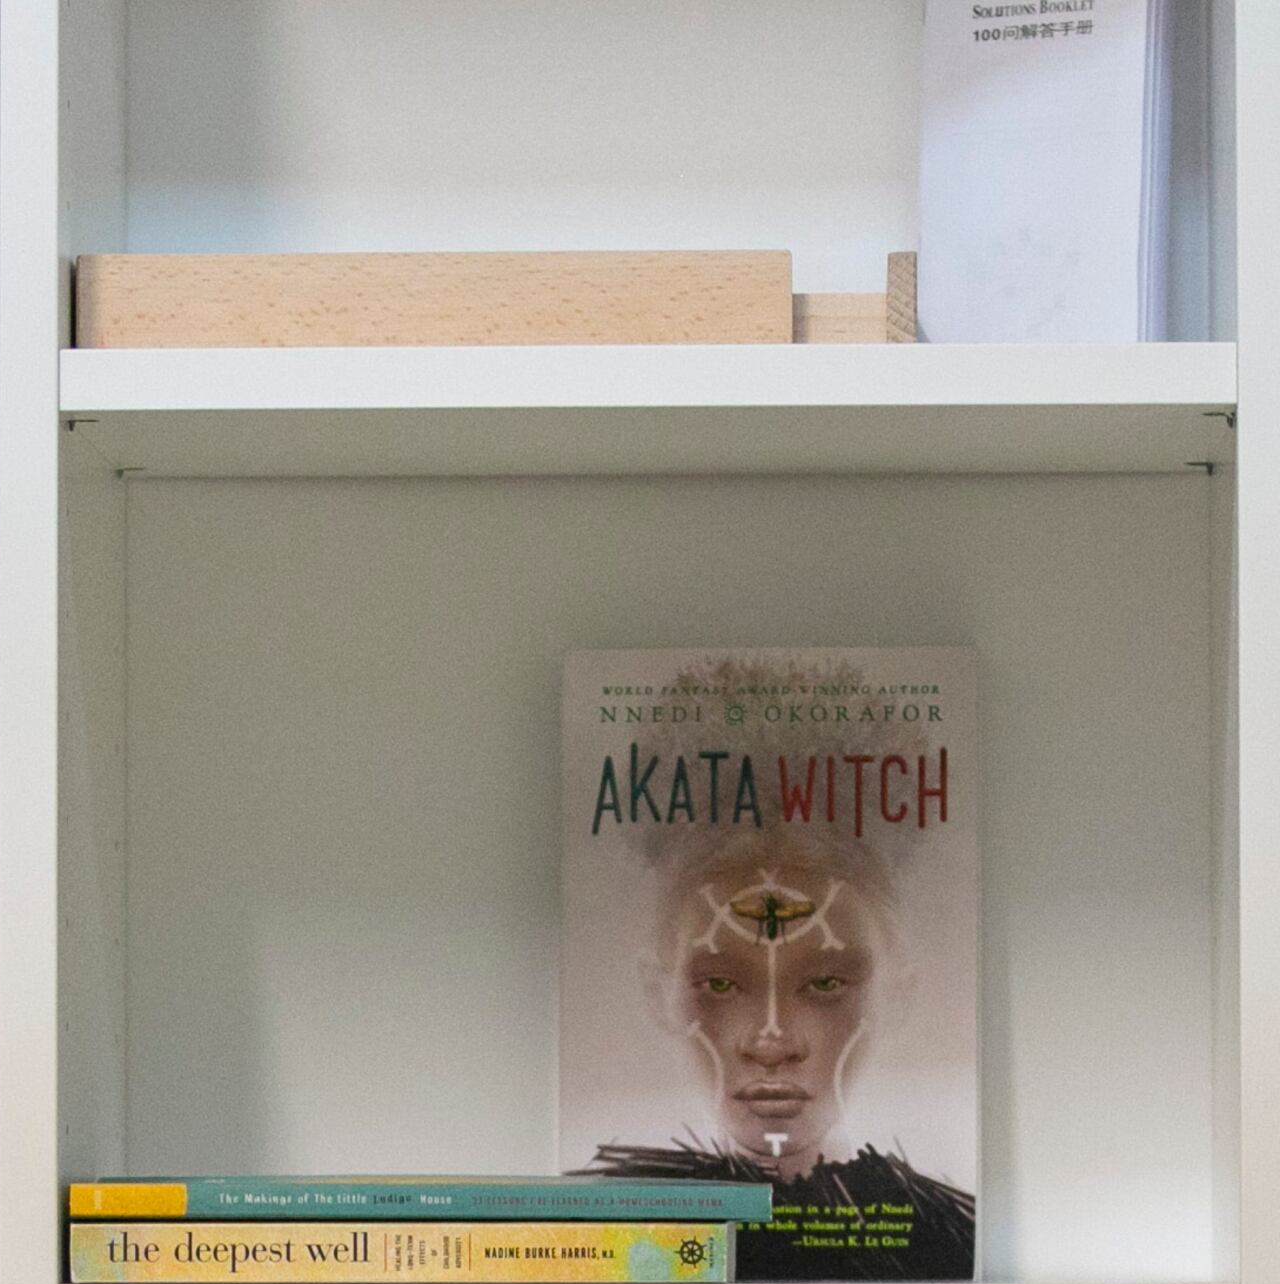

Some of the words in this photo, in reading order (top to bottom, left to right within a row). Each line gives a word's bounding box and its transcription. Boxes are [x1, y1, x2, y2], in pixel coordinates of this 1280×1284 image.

[878, 684, 941, 695] AUTHOR
[599, 705, 702, 723] NNEDI
[764, 704, 943, 723] OKORAFOR
[592, 742, 762, 836] AKATA
[778, 747, 948, 838] WITCH
[220, 1194, 239, 1204] The
[244, 1194, 292, 1207] Makings
[314, 1194, 333, 1204] The
[835, 1206, 861, 1219] page
[881, 1203, 913, 1215] Nnedi
[766, 1221, 797, 1232] whole
[803, 1221, 844, 1232] volumes
[865, 1221, 912, 1234] ordinary
[107, 1231, 160, 1264] the
[174, 1231, 295, 1273] deepest
[306, 1232, 369, 1264] well
[484, 1247, 521, 1260] NADINE
[525, 1247, 556, 1260] BURKE
[561, 1247, 600, 1261] HARRIS,
